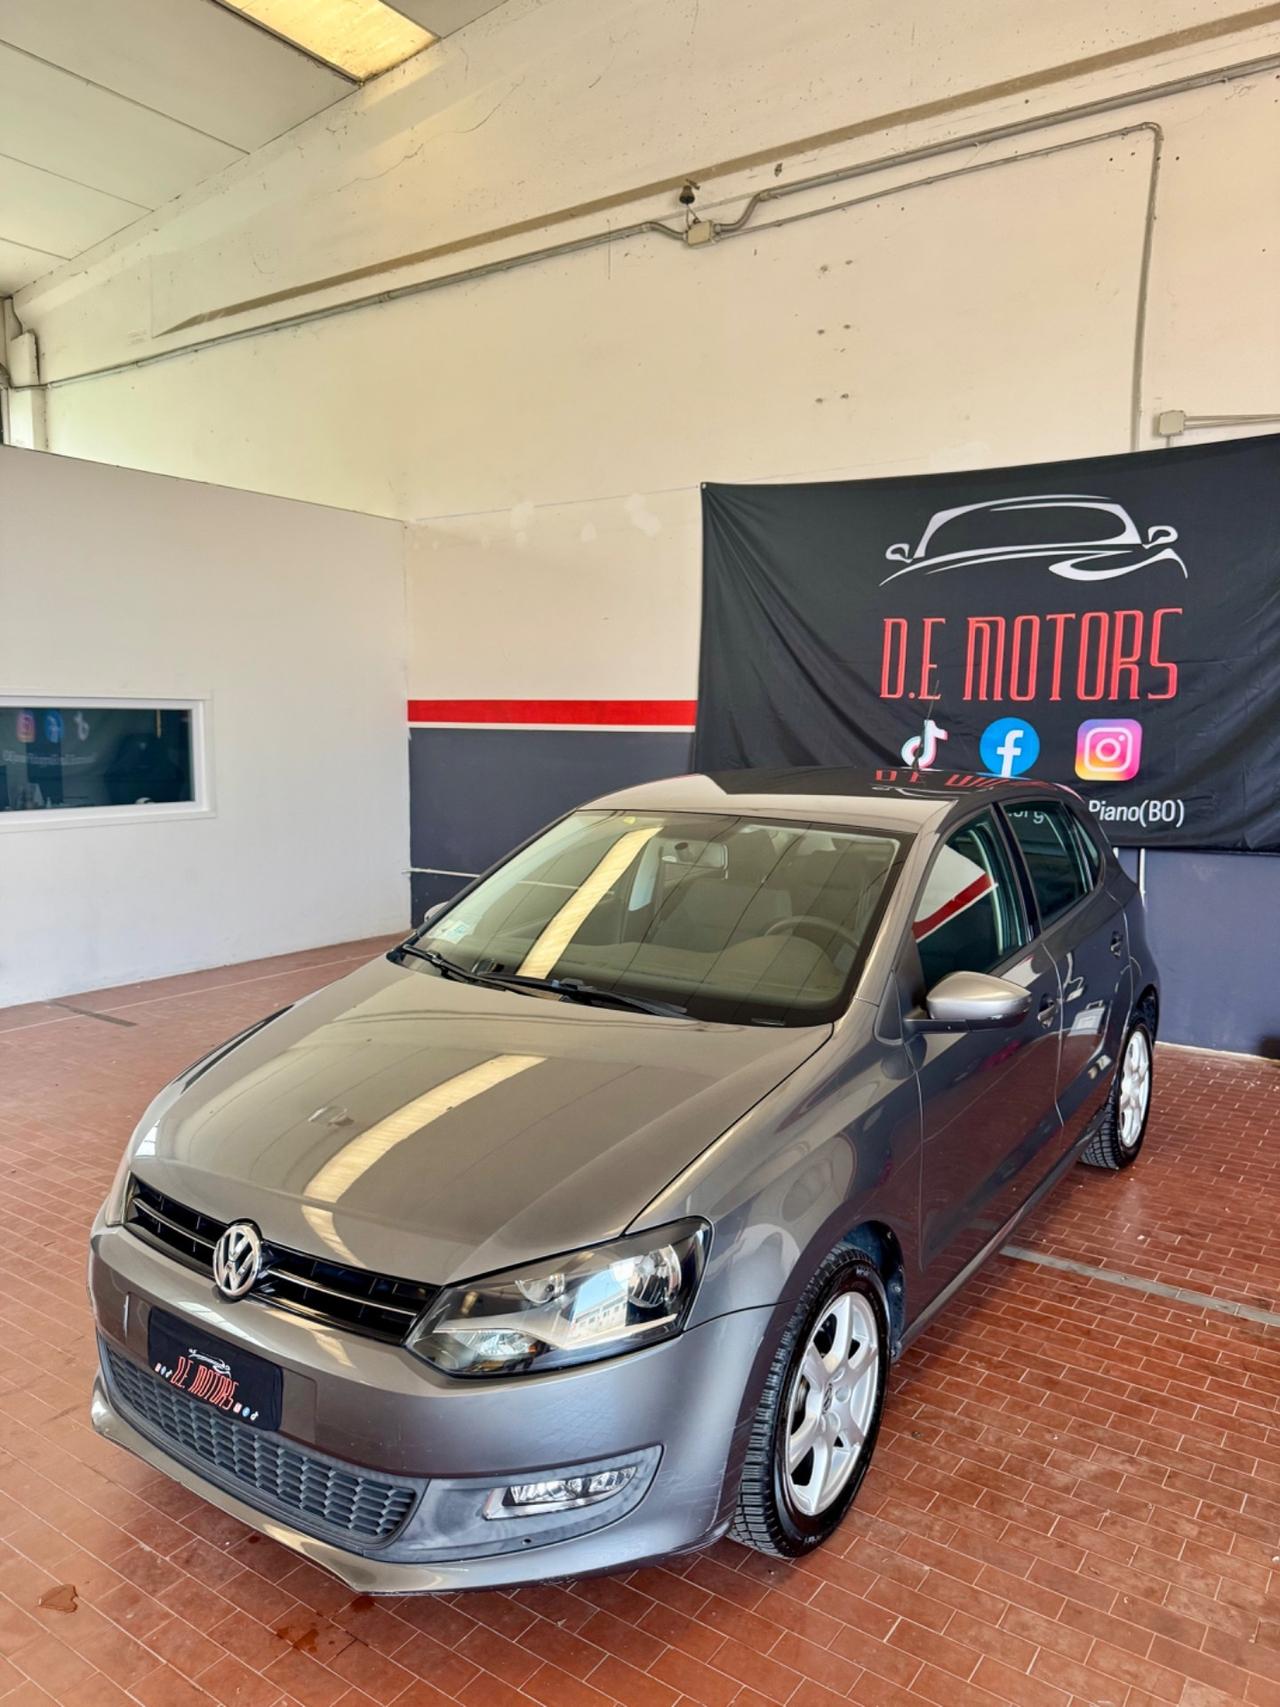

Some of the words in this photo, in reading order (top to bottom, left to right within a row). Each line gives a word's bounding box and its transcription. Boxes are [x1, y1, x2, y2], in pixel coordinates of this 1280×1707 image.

[880, 617, 946, 700] D.E
[963, 608, 1183, 701] MOTORS
[188, 1364, 239, 1410] MOTORS
